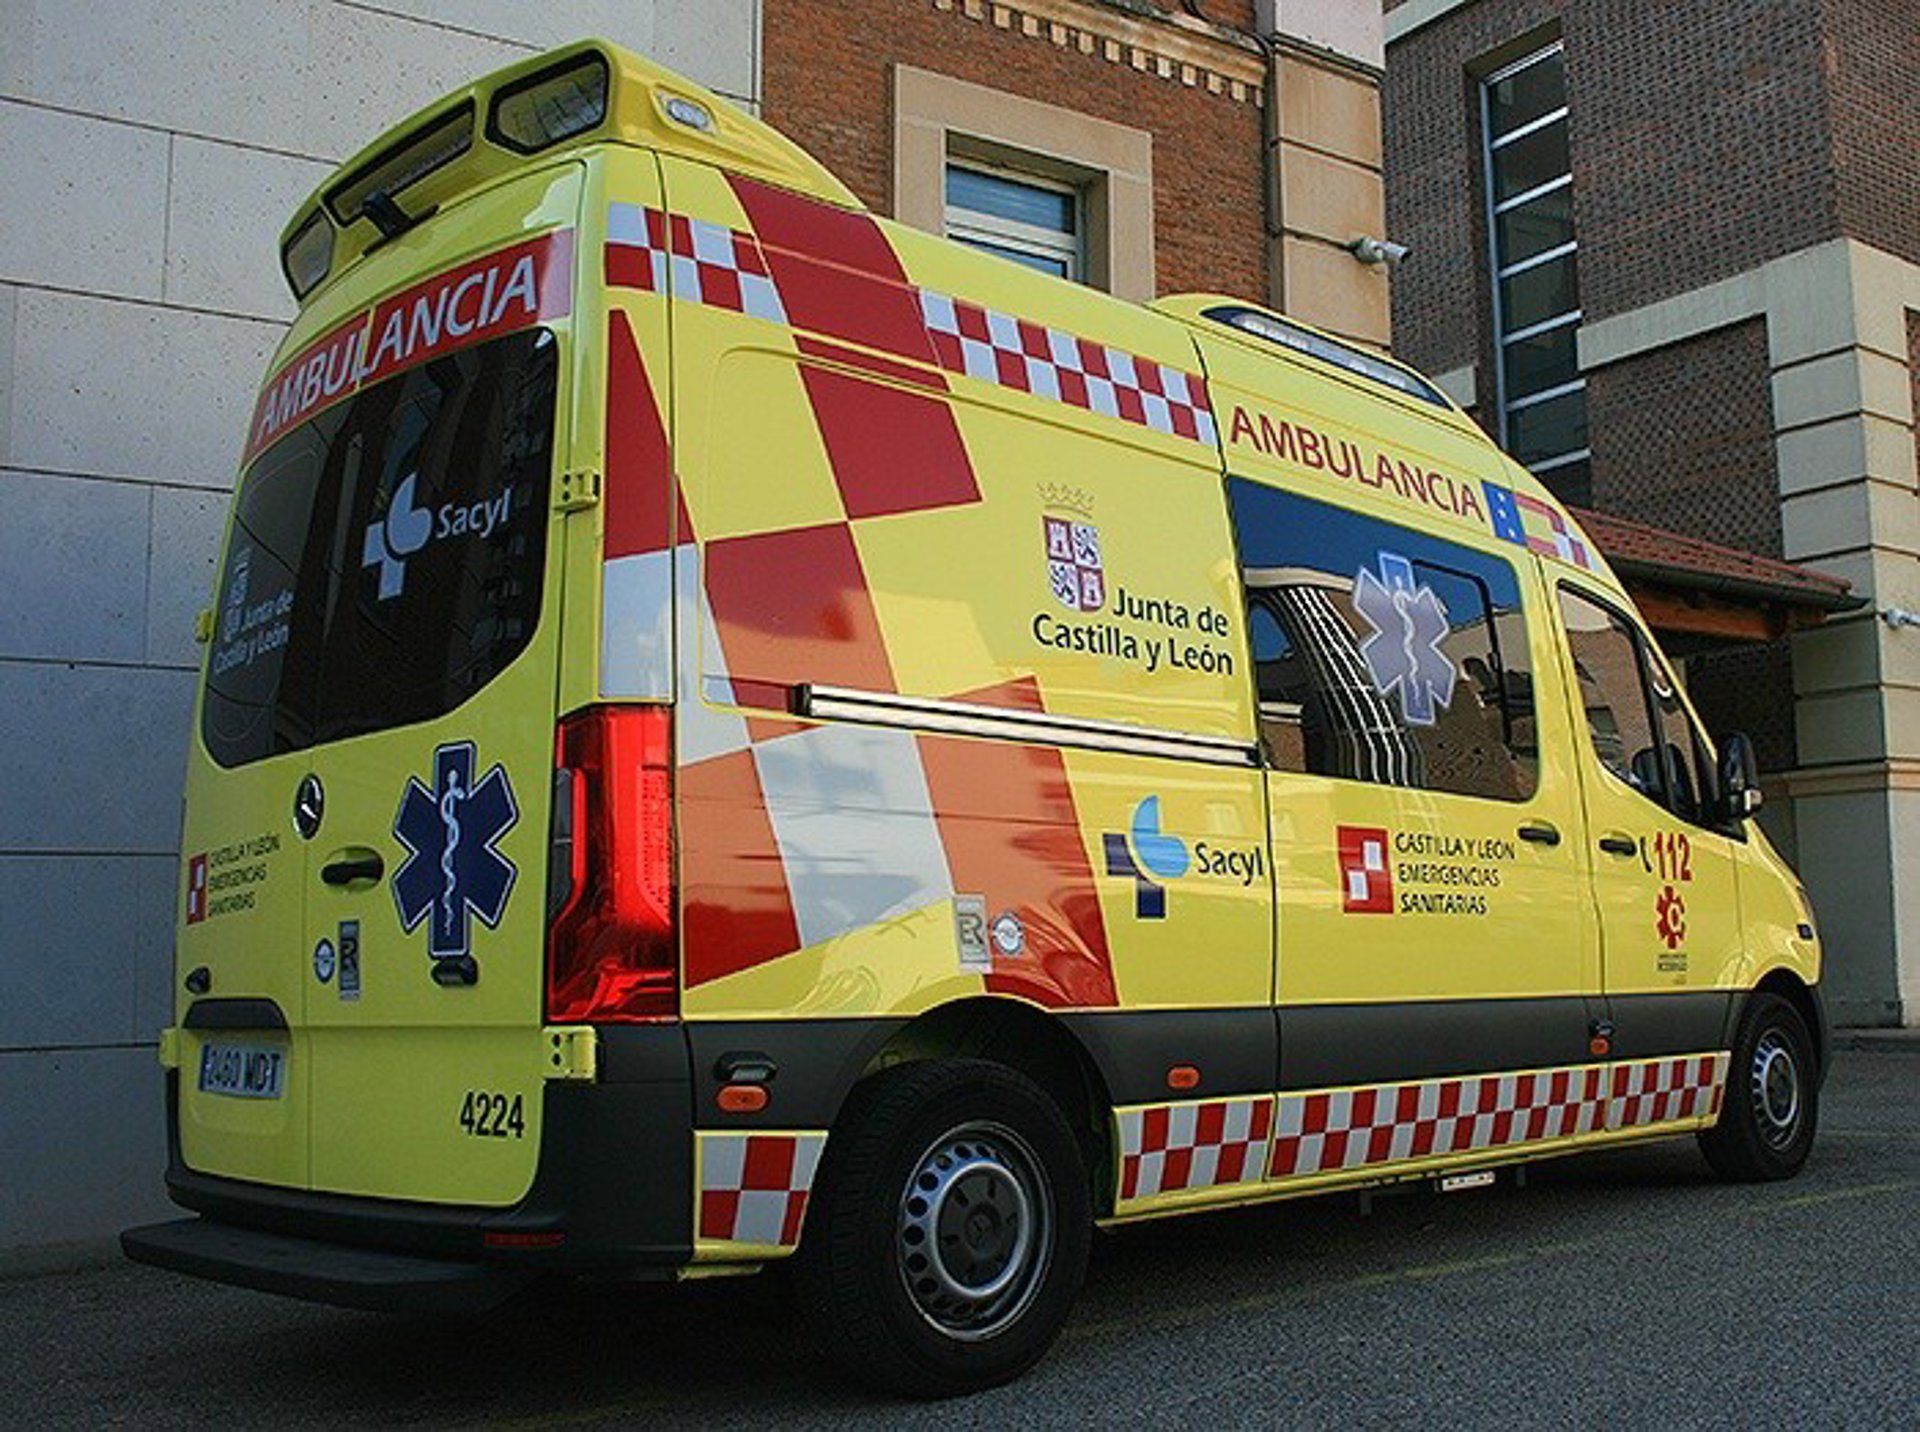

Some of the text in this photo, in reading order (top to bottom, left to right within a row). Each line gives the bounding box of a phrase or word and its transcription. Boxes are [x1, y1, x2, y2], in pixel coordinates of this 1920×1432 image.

[253, 254, 538, 446] AMBULANCIA
[1230, 405, 1484, 523] AMBULANCIA
[436, 487, 511, 539] Sacyl
[1113, 587, 1228, 637] Junta de
[1033, 613, 1233, 675] Castilla y León
[1194, 841, 1263, 887] Sacyl
[1395, 832, 1465, 857] CASTILLA
[1654, 830, 1692, 882] 112
[1398, 862, 1501, 888] EMERGENCIAS
[1401, 892, 1488, 915] SANITARIAS
[459, 1090, 526, 1138] 4224
